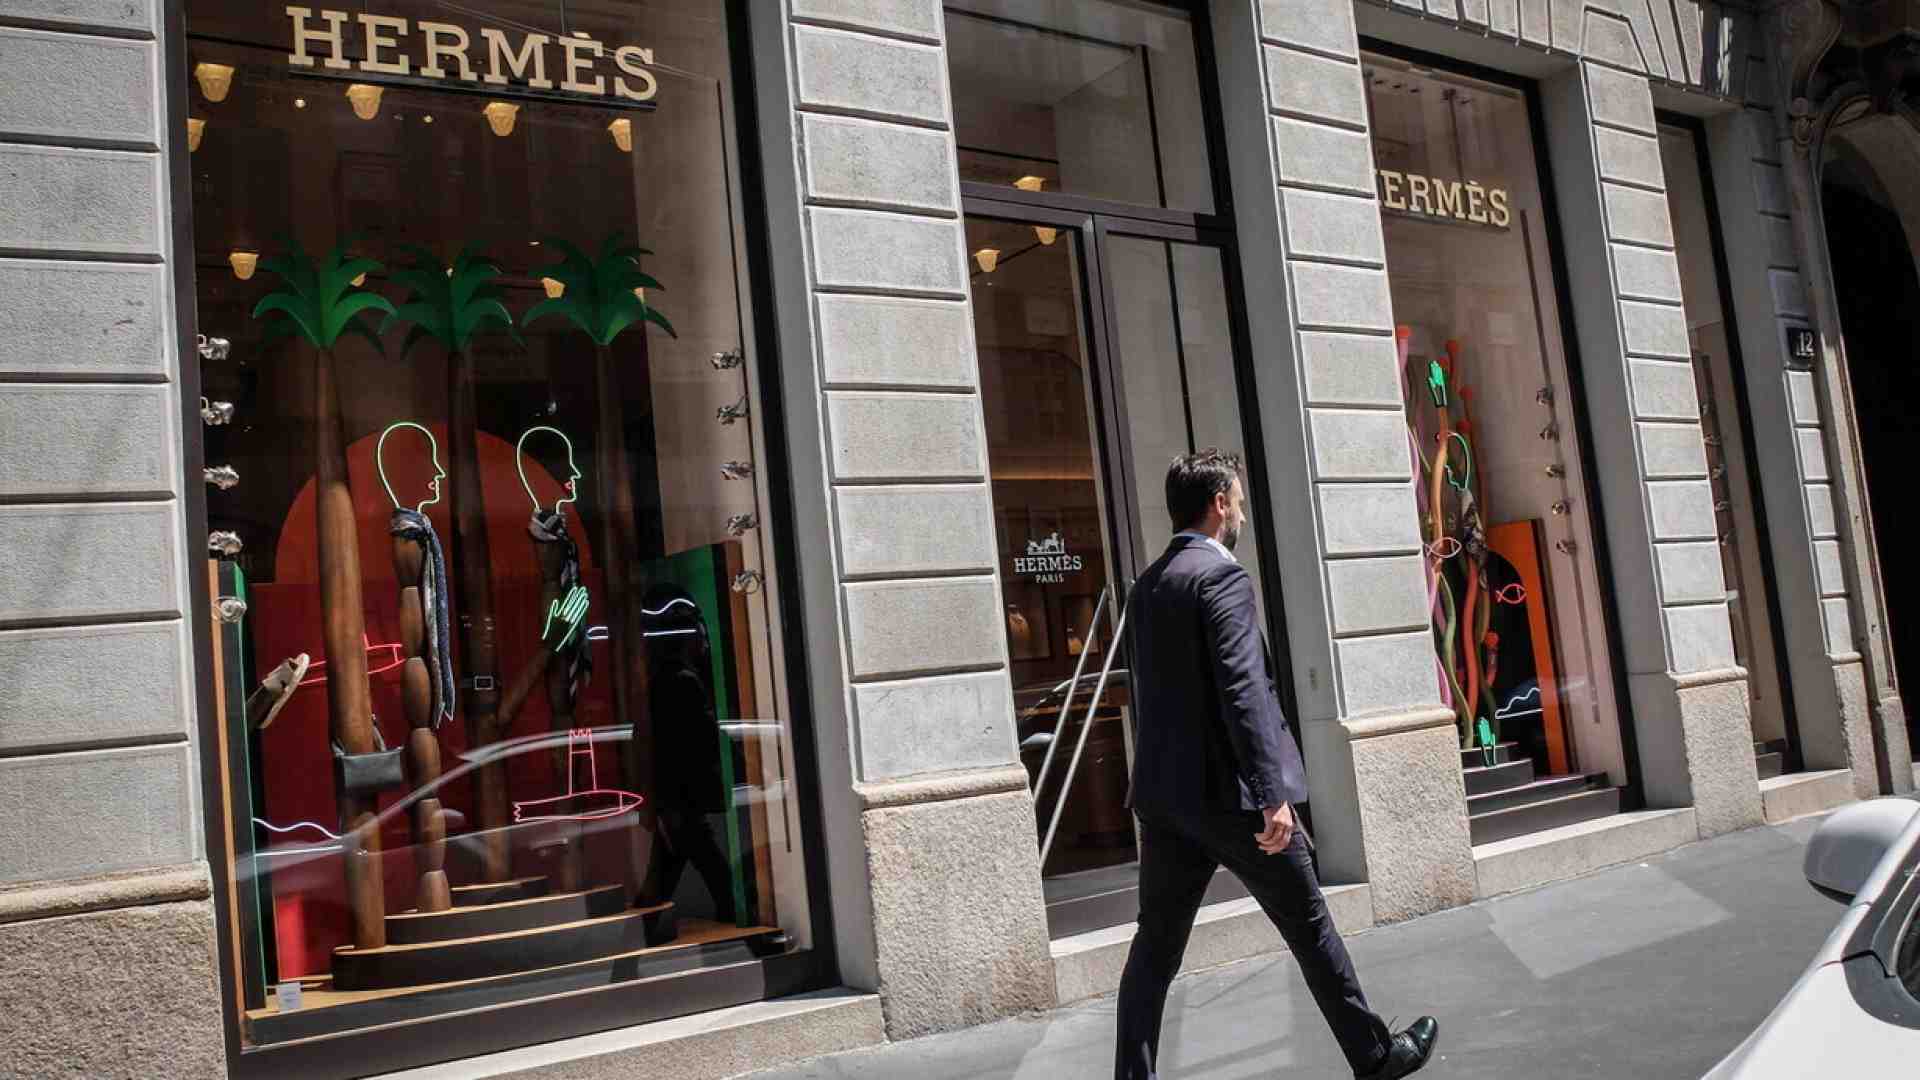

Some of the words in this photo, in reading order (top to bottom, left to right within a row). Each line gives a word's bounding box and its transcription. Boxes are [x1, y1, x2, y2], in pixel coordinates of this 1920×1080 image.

[286, 6, 658, 101] HERMÈS
[1376, 169, 1509, 226] ERMÈS
[1035, 573, 1065, 583] PARIS
